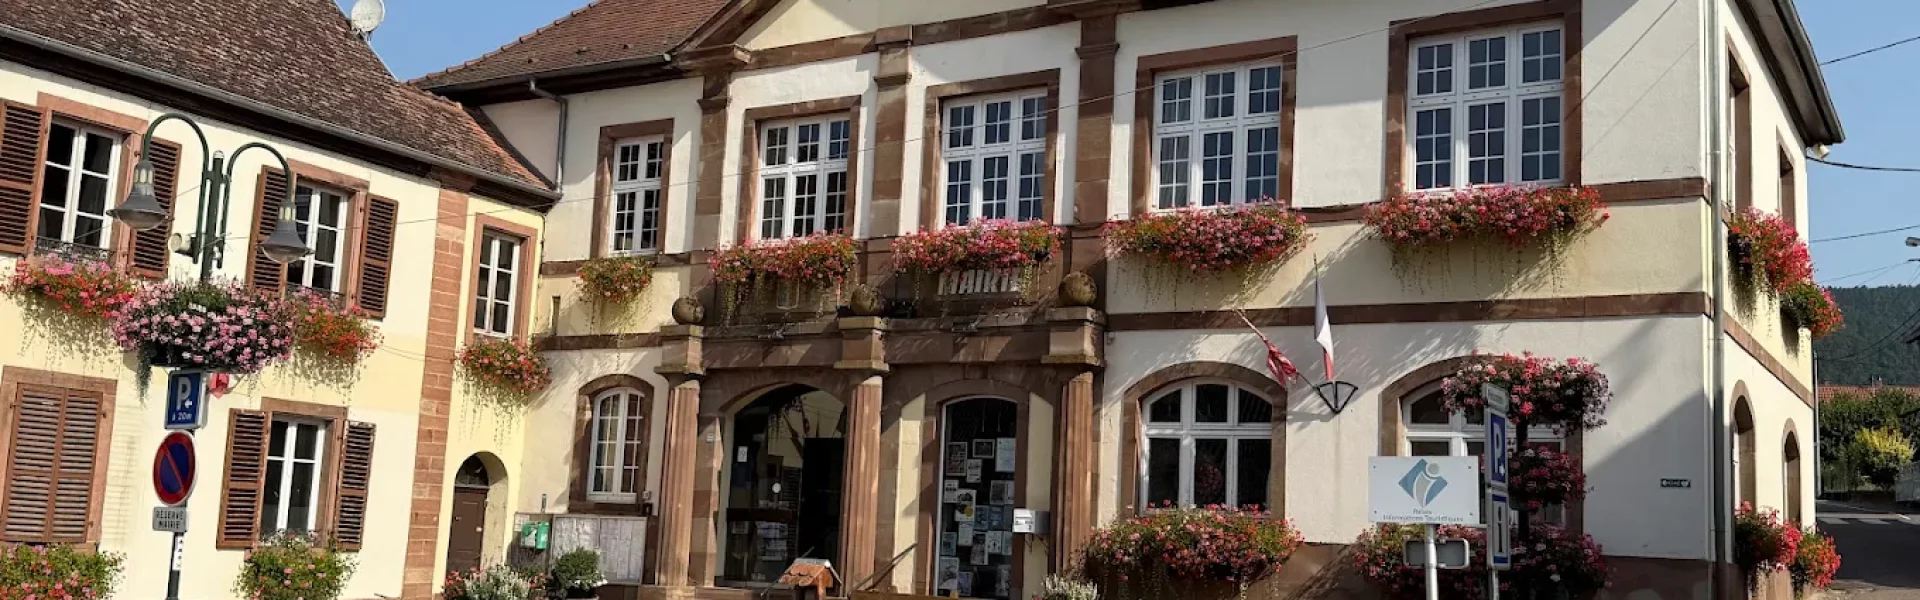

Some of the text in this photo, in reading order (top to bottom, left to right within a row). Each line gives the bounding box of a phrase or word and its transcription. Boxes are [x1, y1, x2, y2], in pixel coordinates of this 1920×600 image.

[177, 376, 191, 410] P
[1493, 422, 1502, 473] P
[158, 520, 181, 529] MAIRIE
